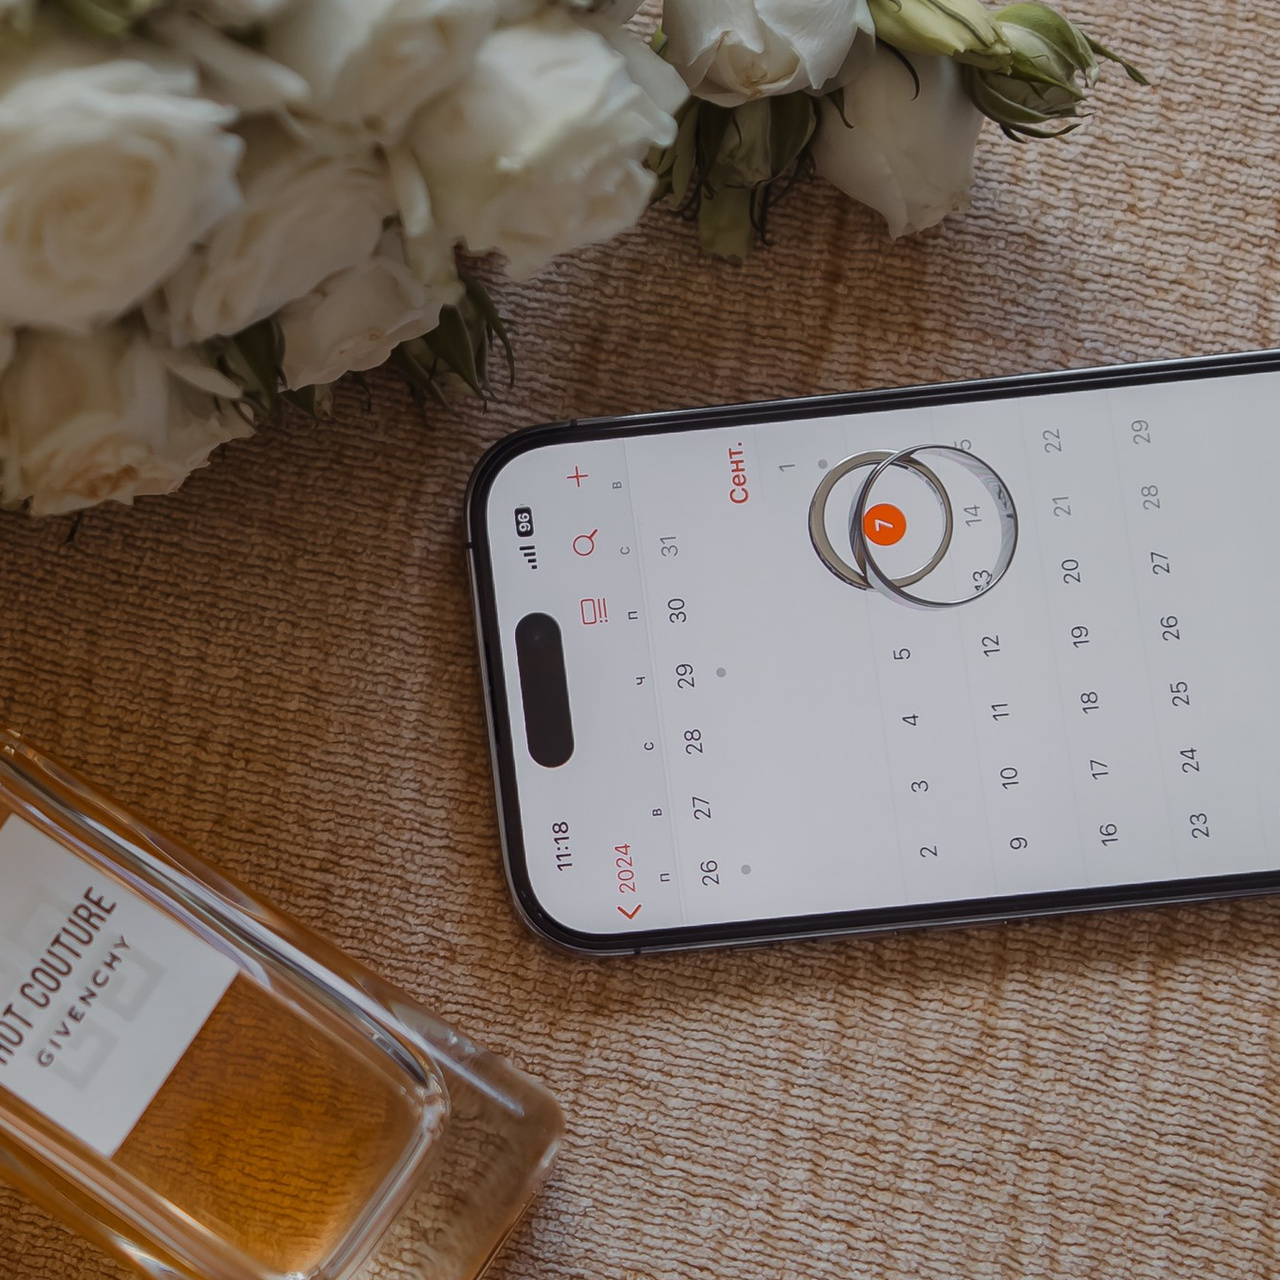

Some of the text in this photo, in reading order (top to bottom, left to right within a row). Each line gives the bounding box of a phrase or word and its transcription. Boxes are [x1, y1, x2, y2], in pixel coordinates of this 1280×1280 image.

[728, 440, 750, 505] Сент.
[518, 511, 532, 533] 96
[963, 504, 983, 528] 14
[1042, 427, 1119, 847] 16 17 18 19 20 21 22
[1130, 418, 1211, 839] 23 24 25 26 27 28 29
[892, 647, 911, 661] 5
[981, 633, 1001, 658] 12
[659, 535, 720, 887] 26 27 28 29 30 31
[901, 712, 920, 727] 4
[990, 701, 1010, 722] 11
[910, 779, 929, 793] 3
[999, 765, 1020, 790] 10
[551, 821, 573, 873] 11:18
[919, 844, 939, 859] 2
[1009, 836, 1028, 851] 9
[614, 843, 637, 894] 2024
[19, 885, 118, 1009] COUTURE
[37, 934, 131, 1068] GIVENCHY
